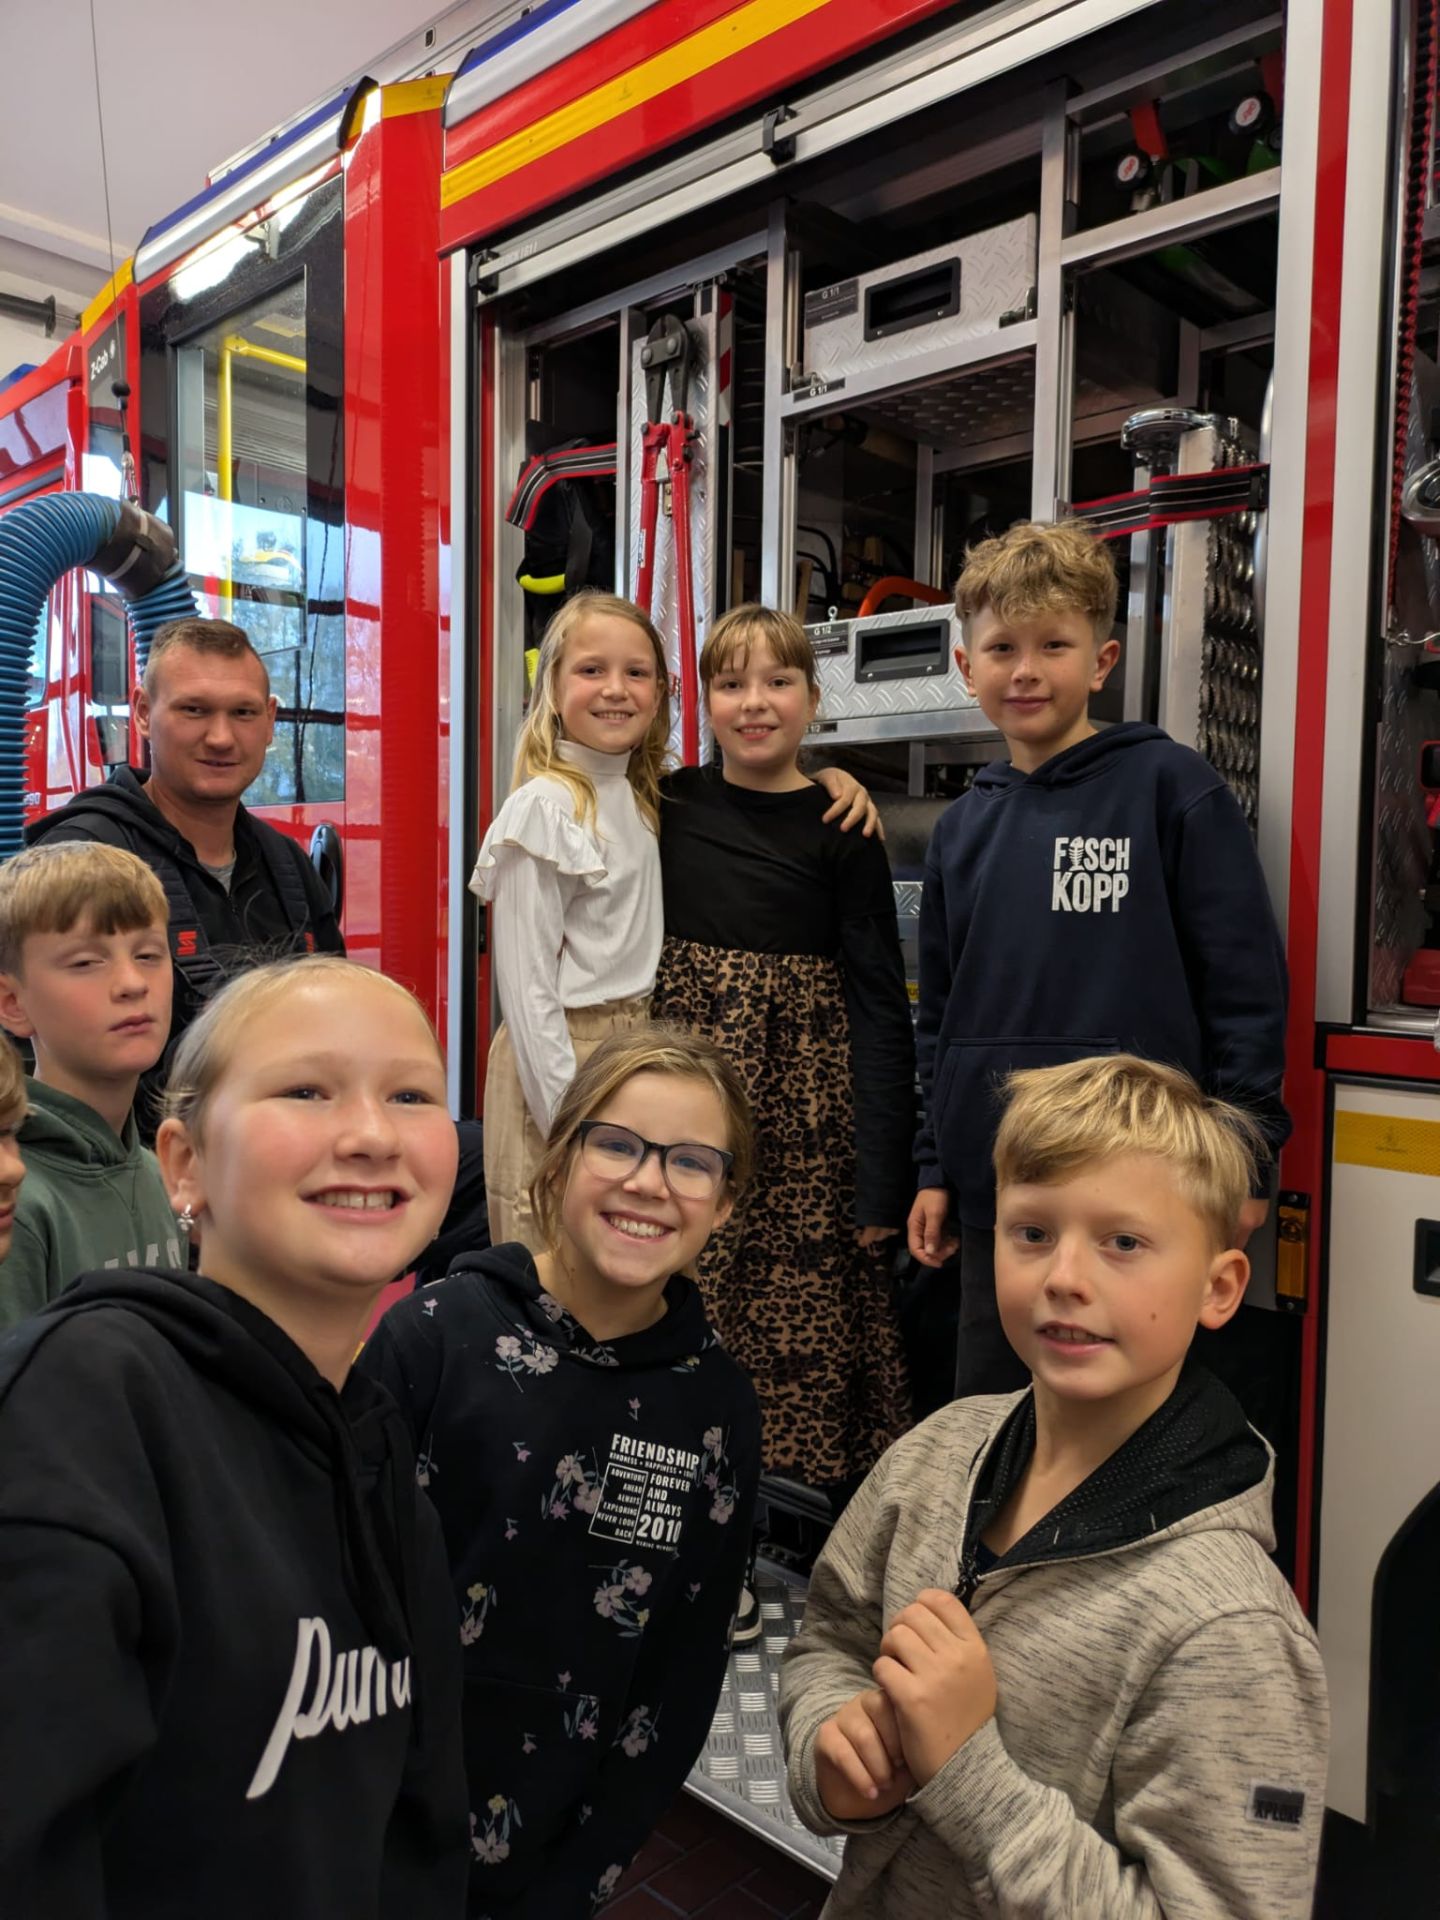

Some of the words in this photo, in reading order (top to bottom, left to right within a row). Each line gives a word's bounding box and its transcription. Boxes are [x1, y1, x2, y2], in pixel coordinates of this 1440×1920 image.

[1051, 871, 1130, 913] KOPP
[611, 1433, 700, 1470] FRIENDSHIP
[609, 1452, 638, 1466] KINDNESS
[644, 1461, 677, 1475] HAPPINESS
[610, 1468, 646, 1483] ADVENTURE
[649, 1473, 691, 1493] FOREVER
[622, 1483, 643, 1494] AHEAD
[647, 1487, 668, 1501] AND
[617, 1493, 641, 1505] ALWAYS
[603, 1502, 638, 1516] EXPLORING
[644, 1500, 683, 1518] ALWAYS
[596, 1511, 617, 1524] NEVER
[618, 1517, 636, 1528] LOOK
[614, 1527, 633, 1539] BACK
[637, 1514, 682, 1543] 2010
